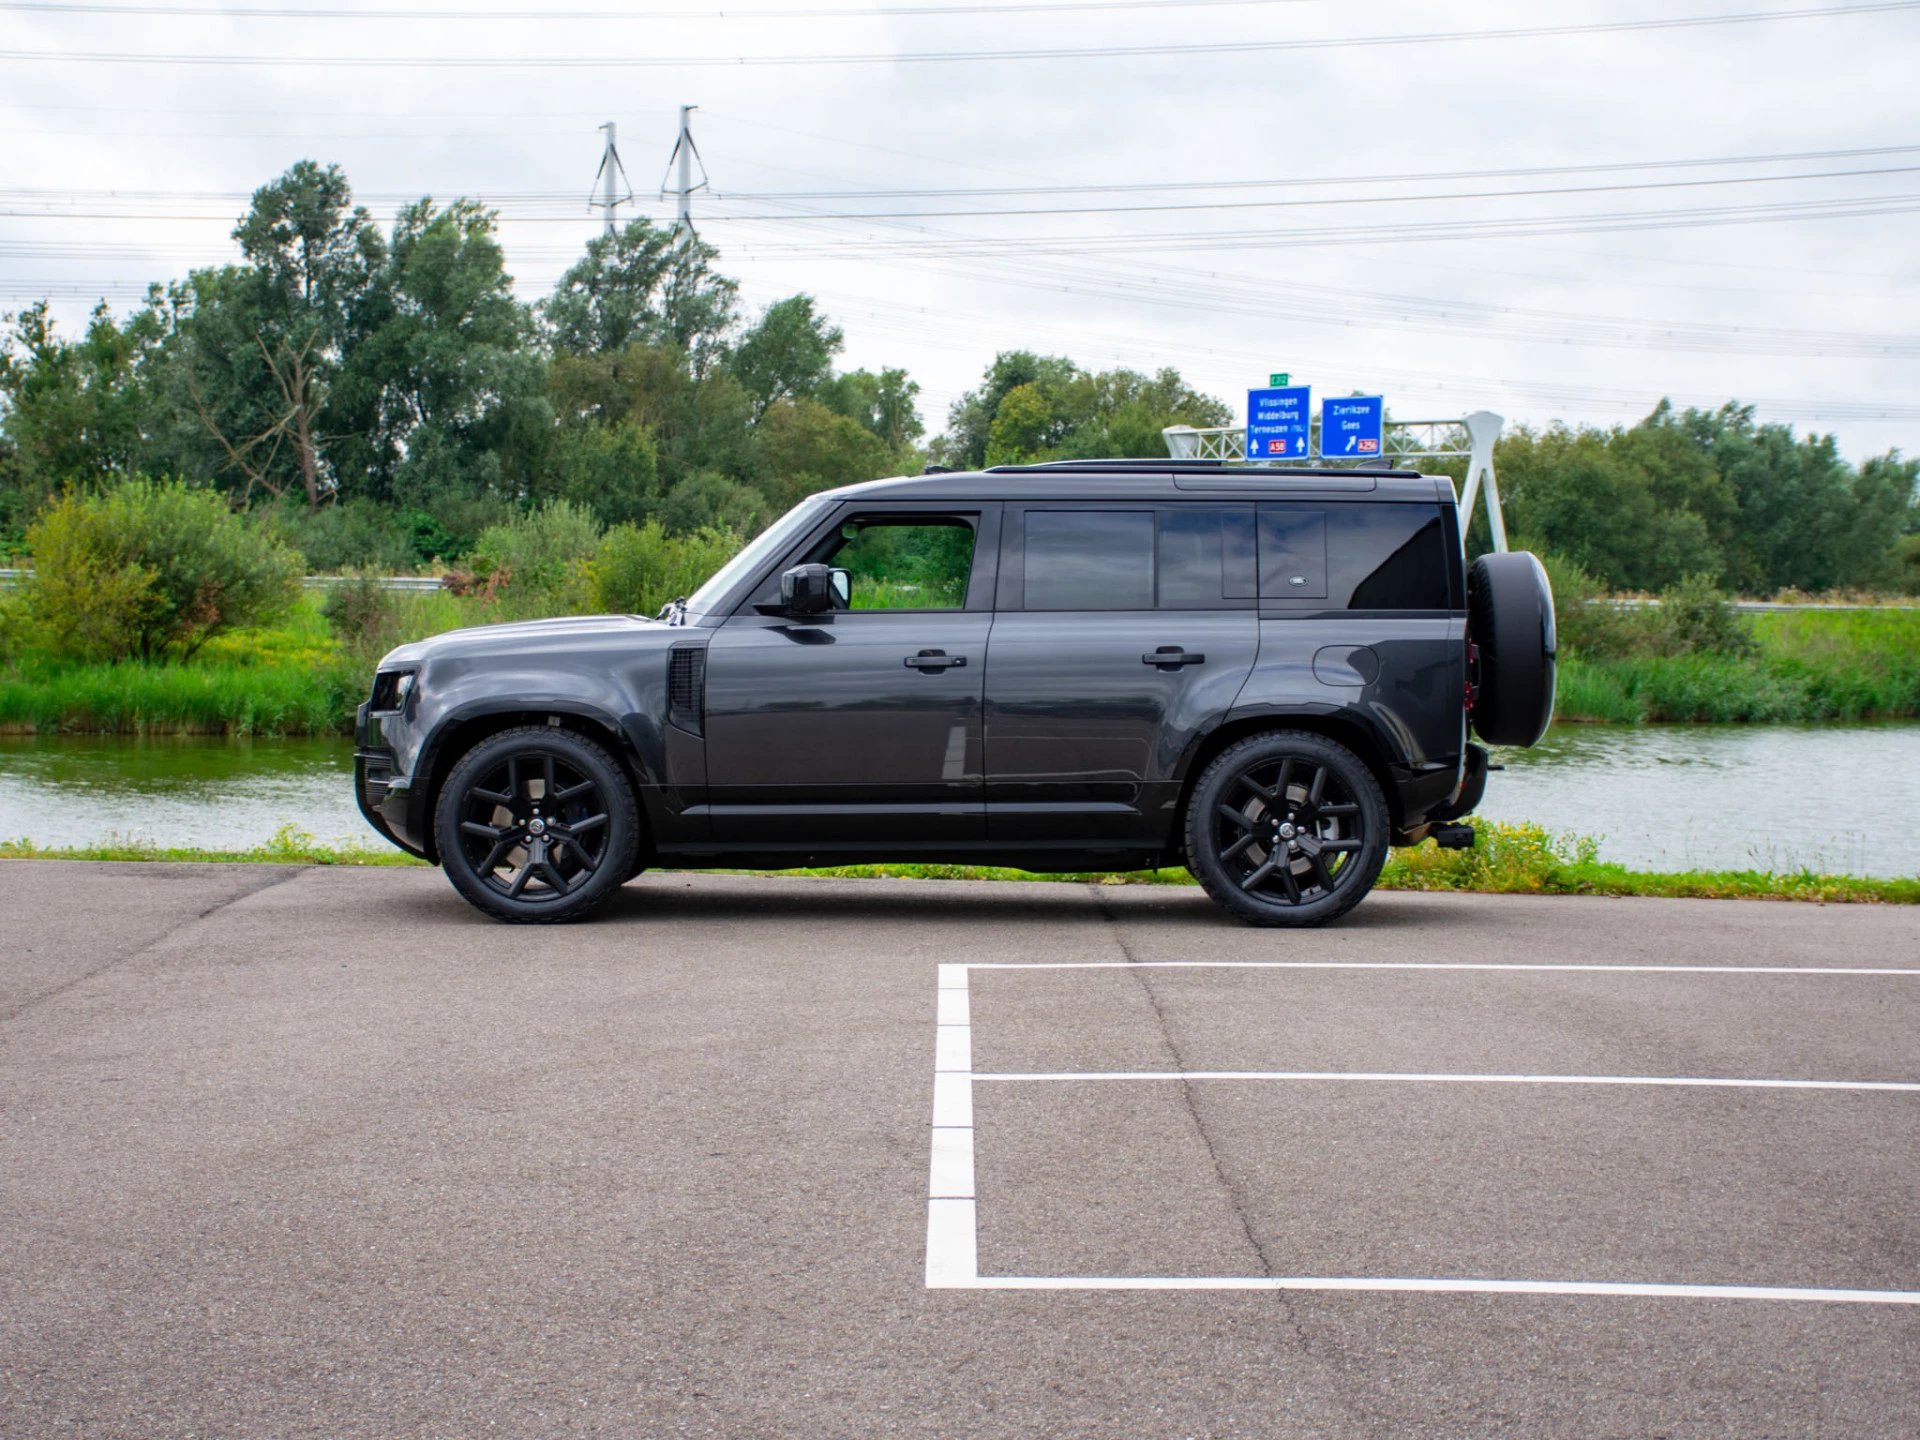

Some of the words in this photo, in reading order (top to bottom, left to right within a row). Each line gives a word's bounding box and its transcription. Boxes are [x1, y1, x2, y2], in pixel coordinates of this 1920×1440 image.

[1259, 397, 1298, 408] Vlissingen
[1257, 410, 1299, 422] Middelburg
[1332, 405, 1370, 416] Zierikzee
[1250, 424, 1289, 434] Terneuzen
[1341, 420, 1360, 430] Goes
